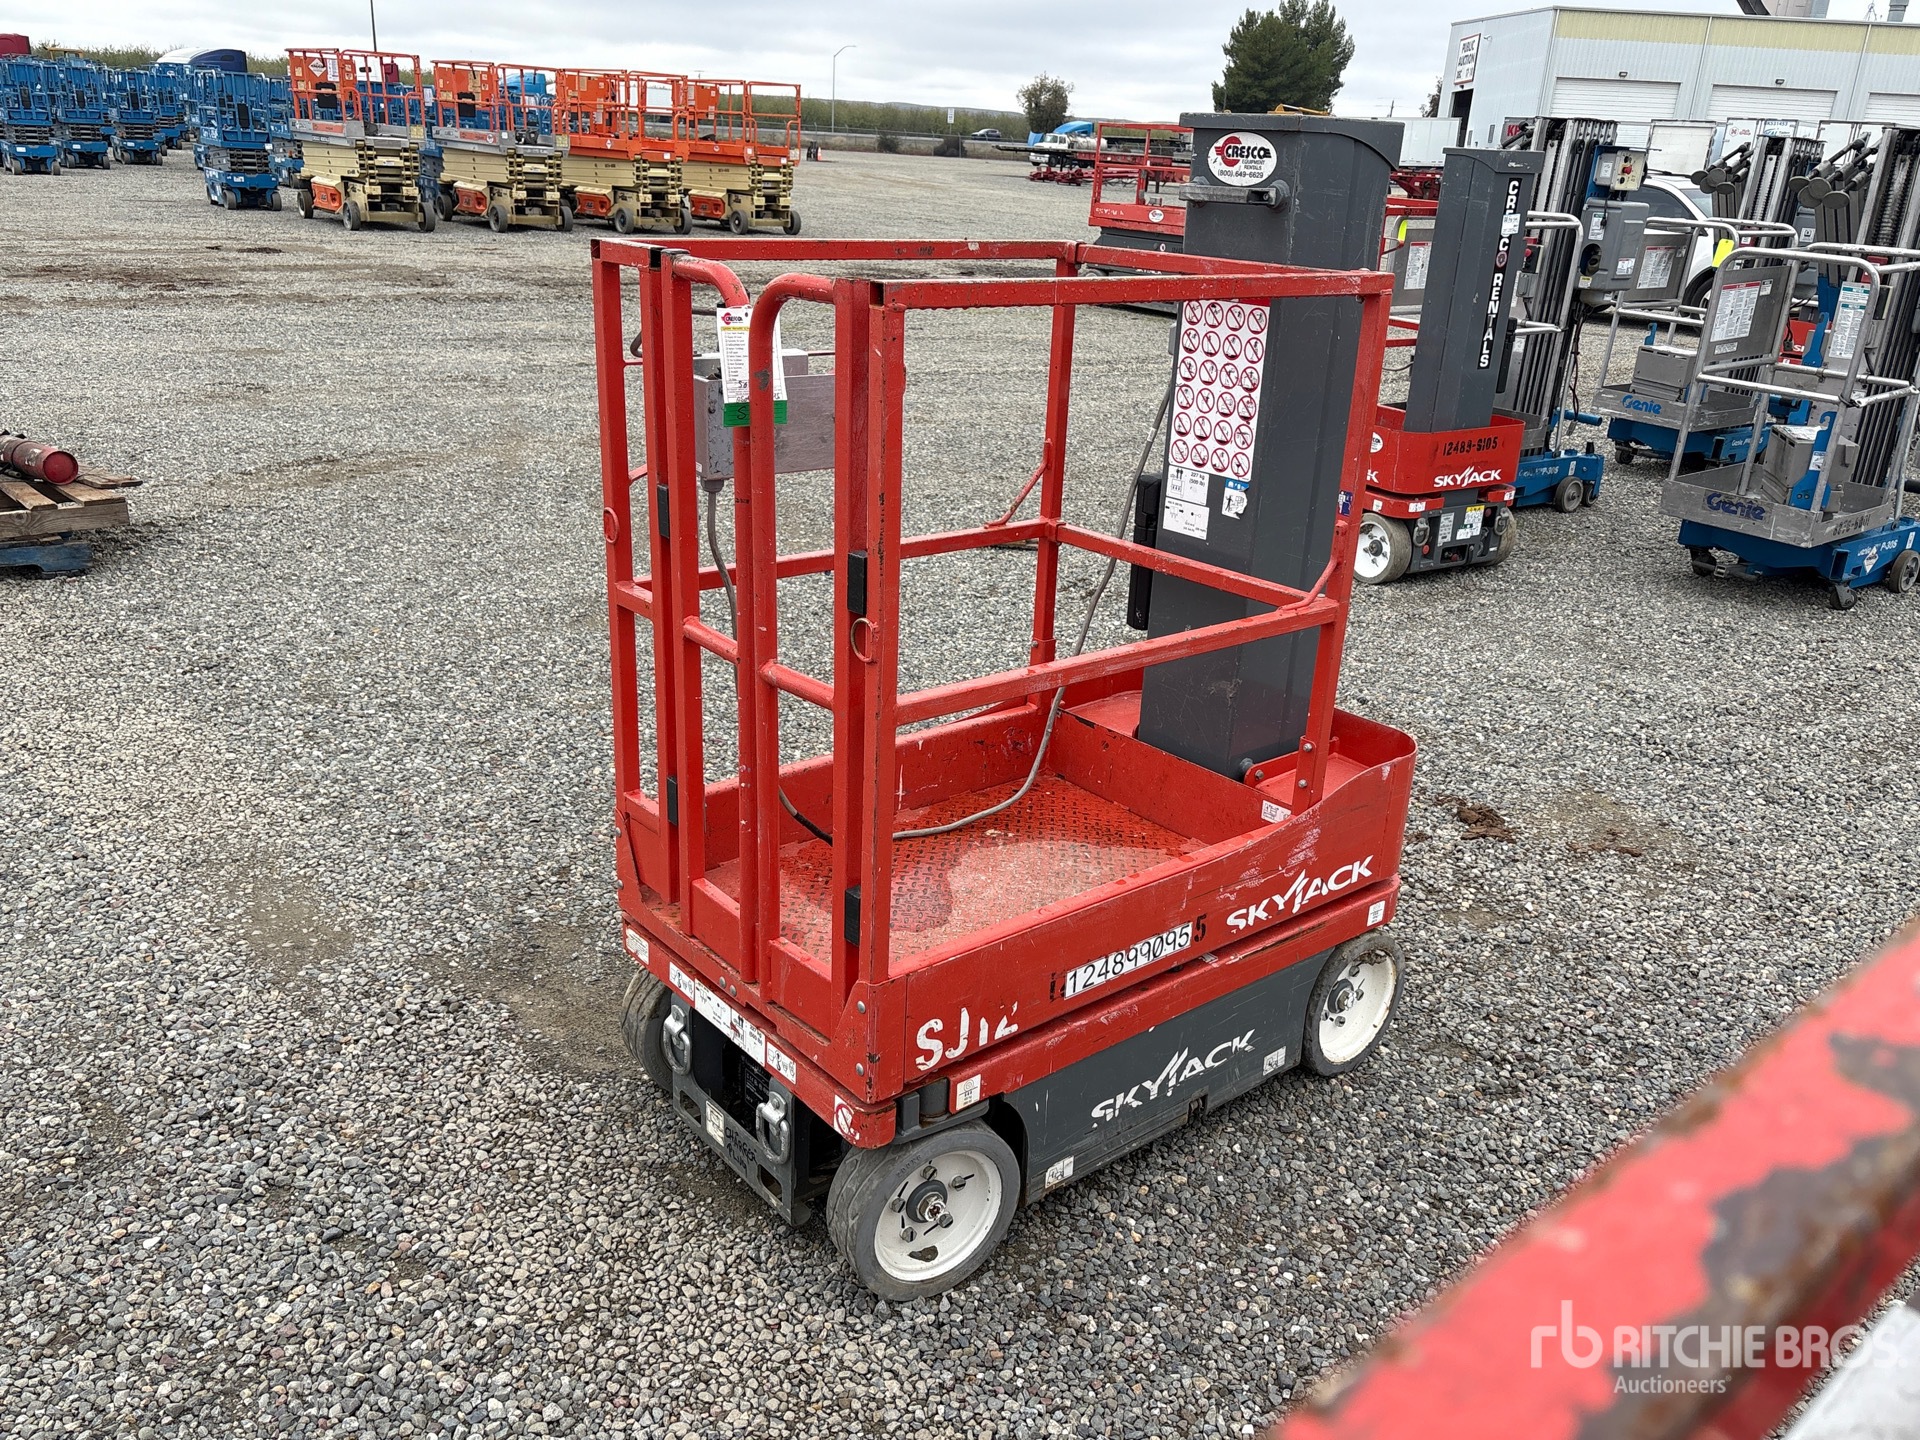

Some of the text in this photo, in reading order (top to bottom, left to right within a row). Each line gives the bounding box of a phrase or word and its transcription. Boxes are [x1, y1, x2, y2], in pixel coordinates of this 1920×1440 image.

[1462, 40, 1475, 54] PUBLIC
[1458, 53, 1475, 66] AUCTION
[1225, 145, 1271, 159] CRESCO
[1235, 171, 1264, 179] 649-6629
[1479, 273, 1504, 368] RENTALS
[1622, 394, 1663, 415] Genie
[1433, 466, 1502, 488] SKYJACK
[1706, 492, 1766, 521] Genie
[1226, 855, 1374, 934] SKYJACK
[1069, 924, 1190, 994] 124899095
[1091, 1028, 1256, 1129] SKYJACK
